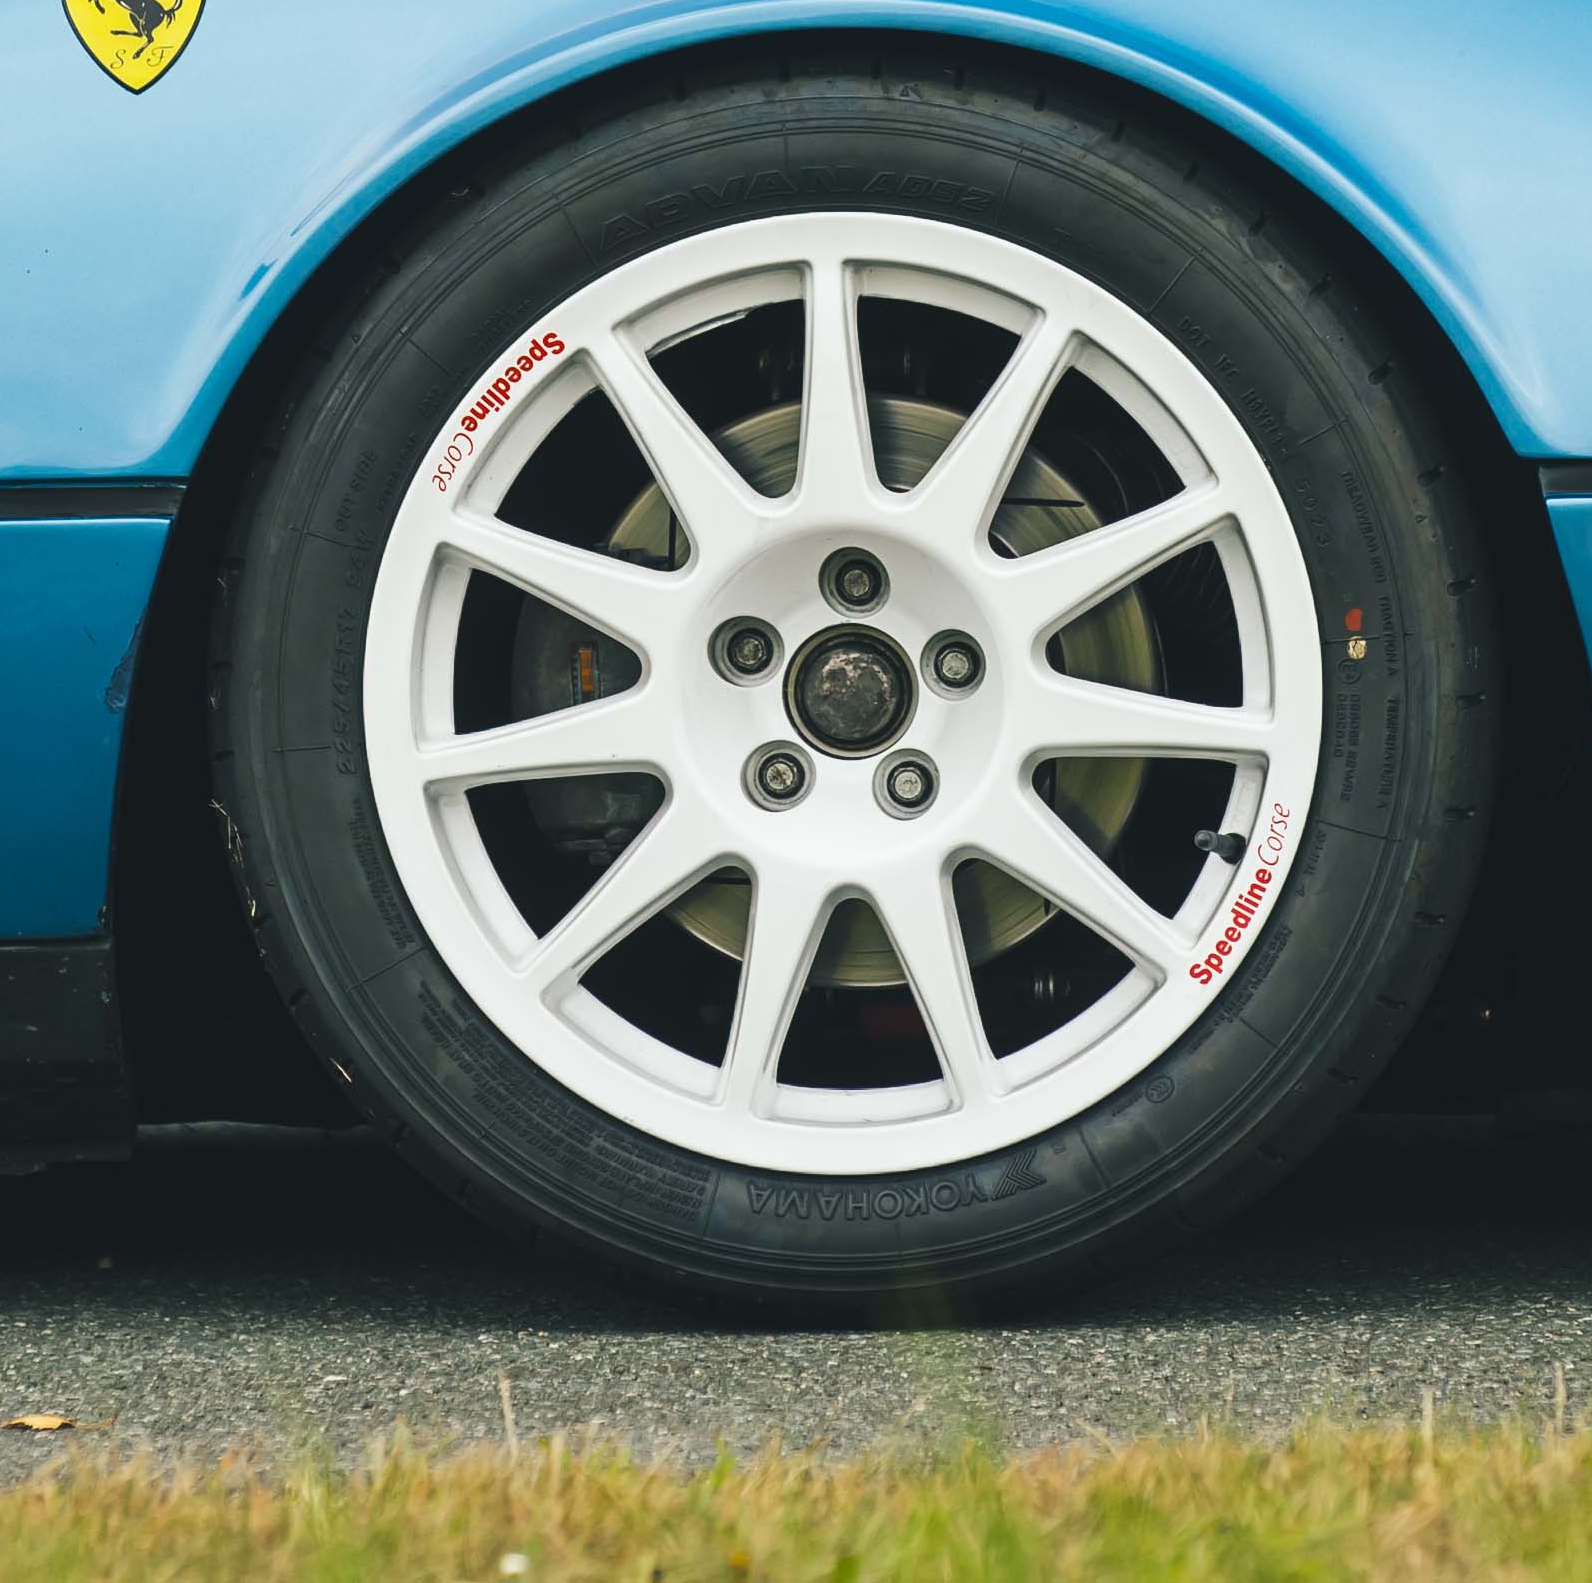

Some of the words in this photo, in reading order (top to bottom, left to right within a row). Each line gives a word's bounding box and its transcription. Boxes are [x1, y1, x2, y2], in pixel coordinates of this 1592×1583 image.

[461, 332, 565, 432] Speedline
[432, 432, 473, 492] Corse
[1189, 868, 1272, 985] Speedline
[1257, 803, 1290, 866] Corse
[746, 1173, 994, 1220] YOKOHAMA
